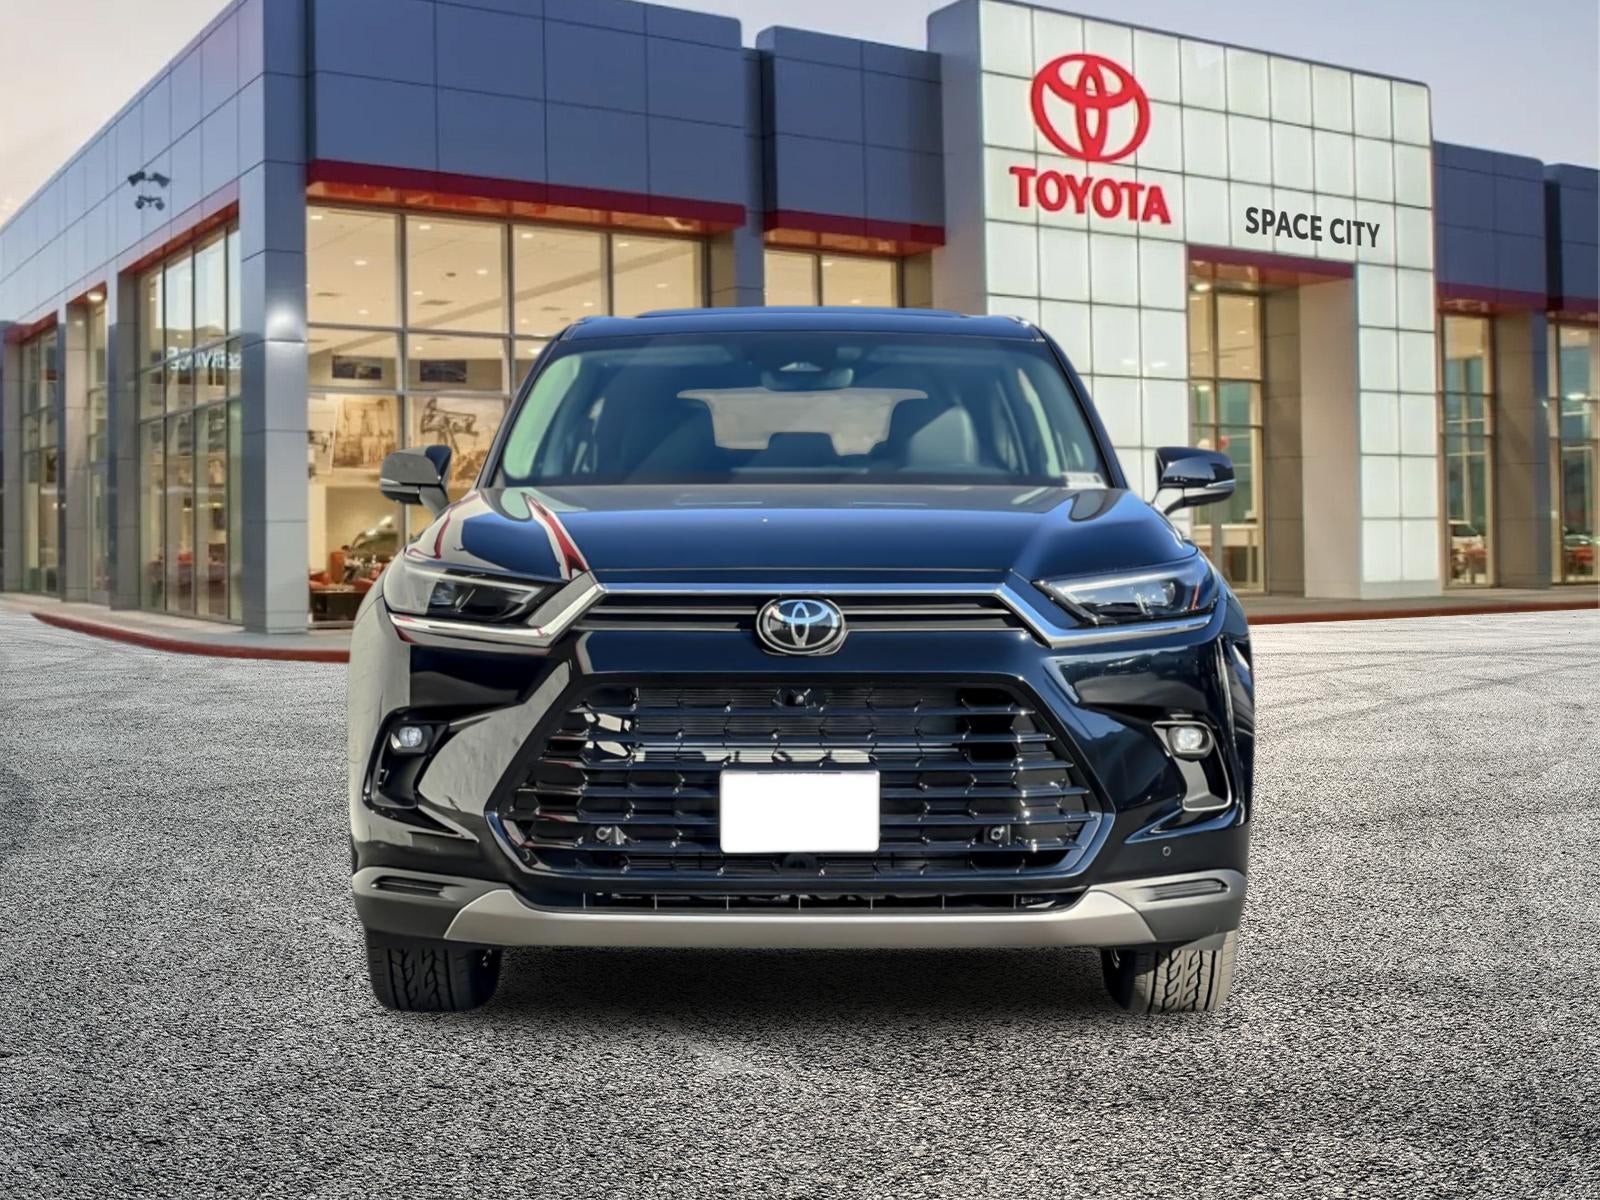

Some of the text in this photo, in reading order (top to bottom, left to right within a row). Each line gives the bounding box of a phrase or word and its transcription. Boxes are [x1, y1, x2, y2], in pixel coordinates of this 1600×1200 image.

[1009, 166, 1171, 224] TOYOTA
[1245, 206, 1381, 248] SPACE CITY
